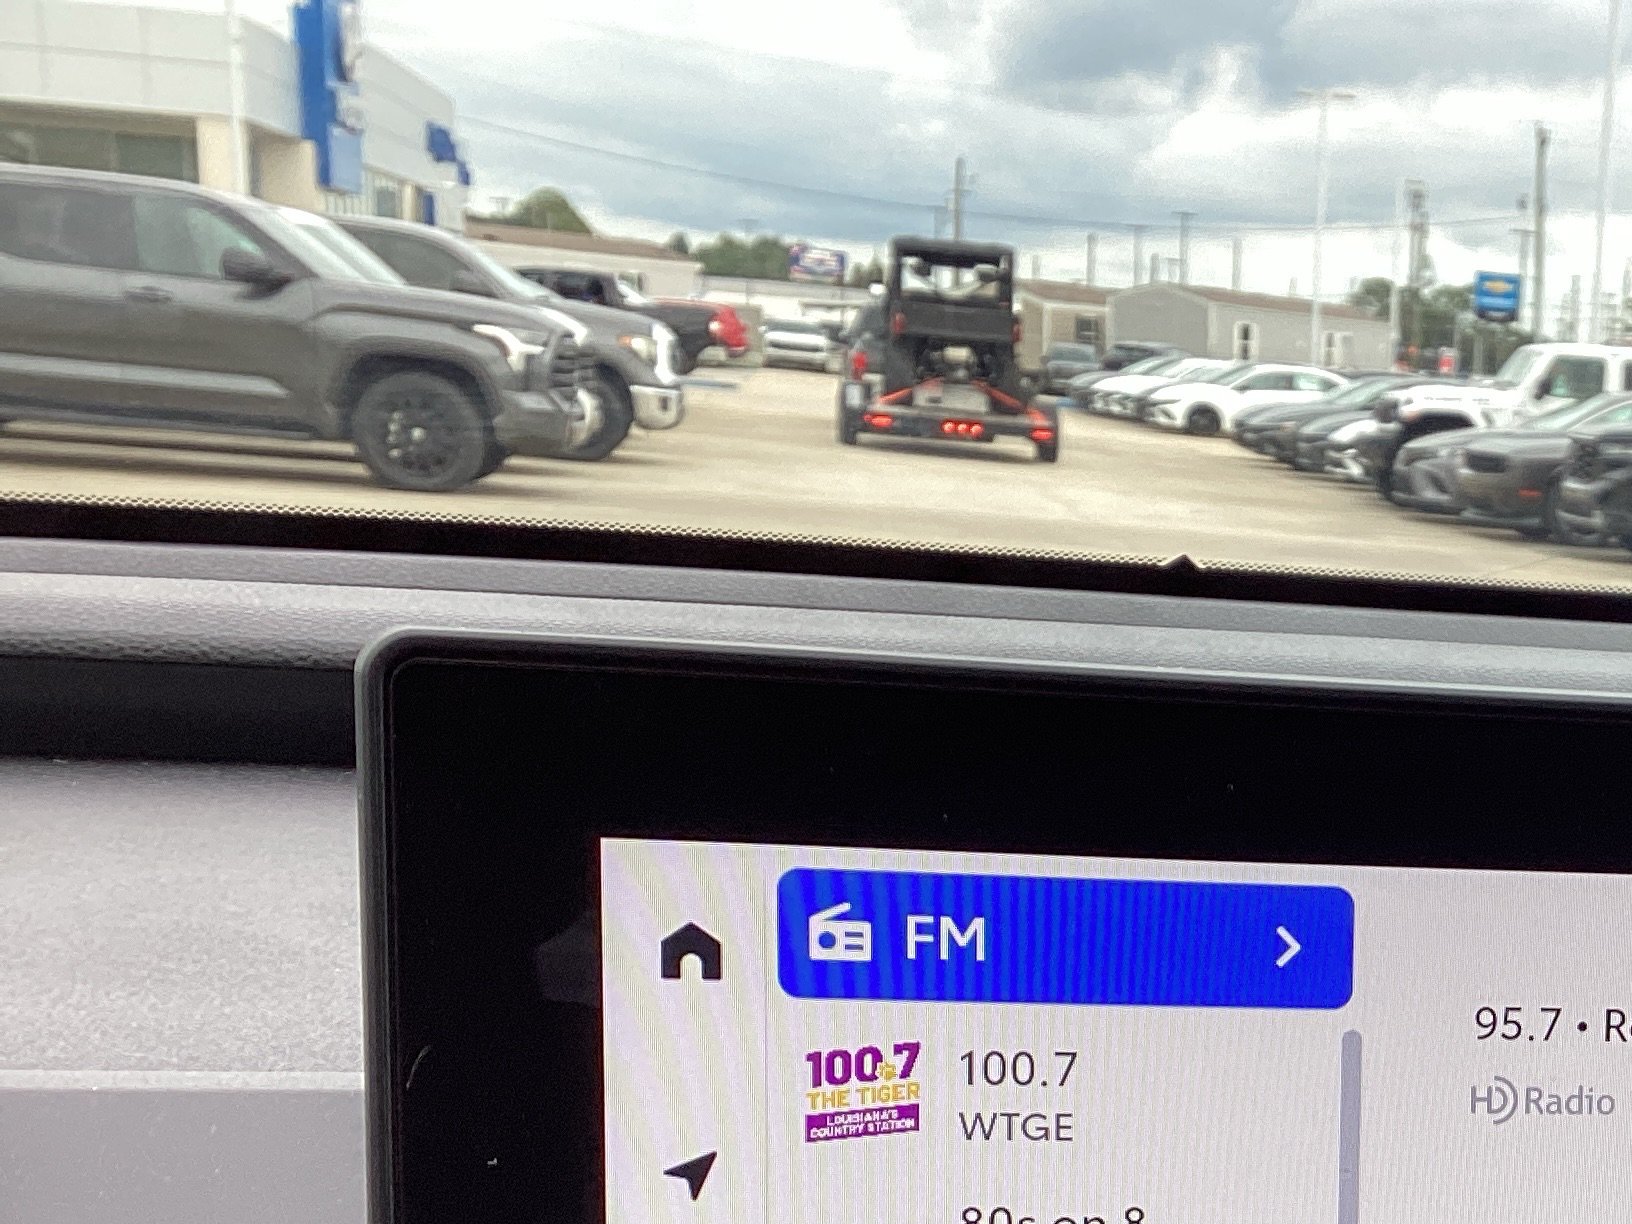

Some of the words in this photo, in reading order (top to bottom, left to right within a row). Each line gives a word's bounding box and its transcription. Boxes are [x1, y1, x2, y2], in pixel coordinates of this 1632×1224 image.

[905, 914, 986, 962] FM
[1476, 1007, 1561, 1041] 95.7
[961, 1051, 1077, 1086] 100.7
[806, 1089, 850, 1110] THE
[856, 1081, 920, 1104] TIGER
[1525, 1085, 1615, 1115] Radio
[959, 1113, 1072, 1141] WTGE
